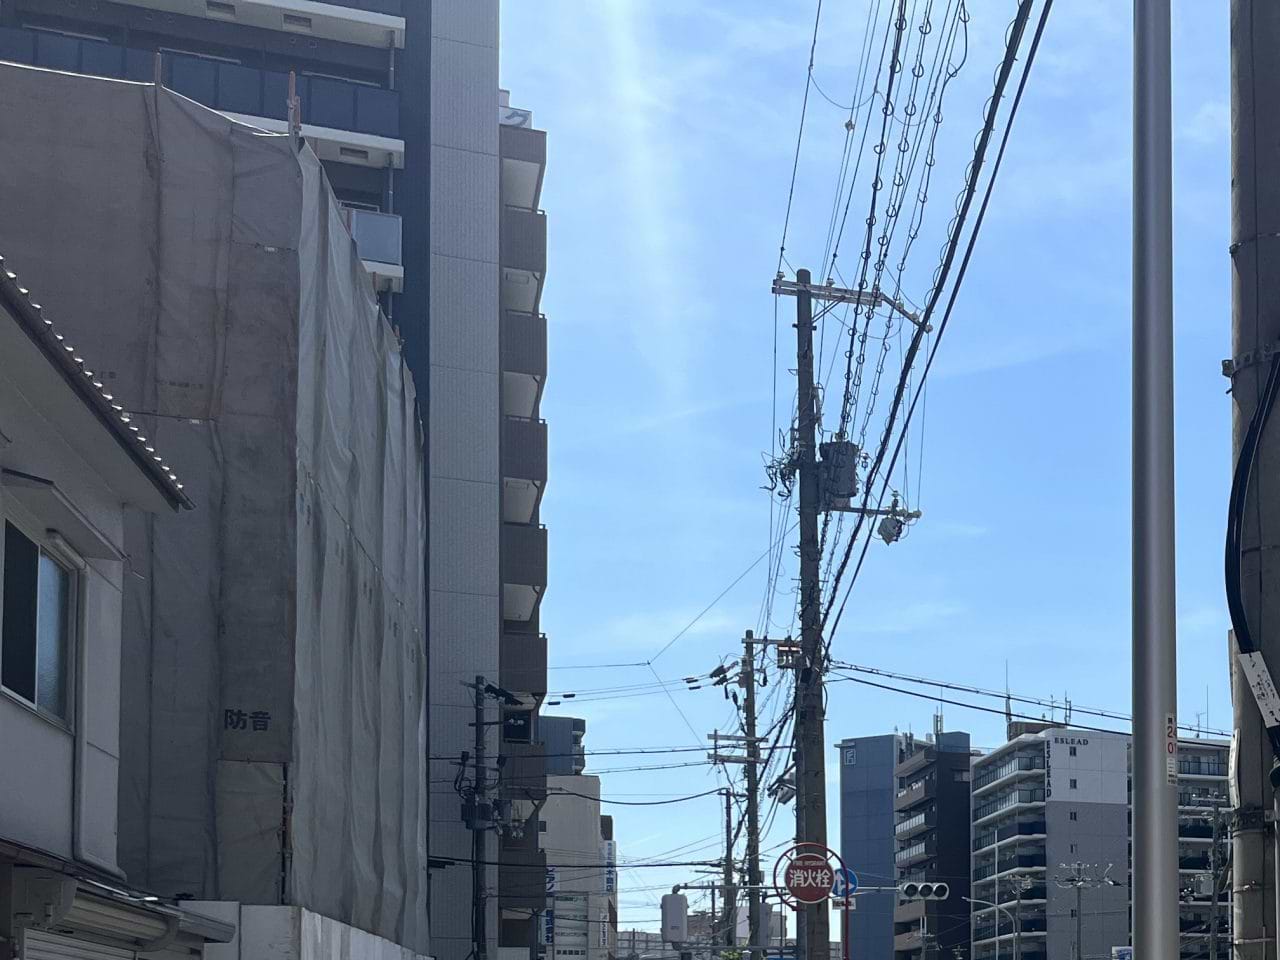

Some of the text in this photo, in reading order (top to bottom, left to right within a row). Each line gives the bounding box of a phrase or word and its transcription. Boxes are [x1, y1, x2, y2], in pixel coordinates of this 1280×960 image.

[224, 708, 271, 731] 防音
[1054, 738, 1089, 746] ESLEAD
[789, 868, 831, 888] 消火栓
